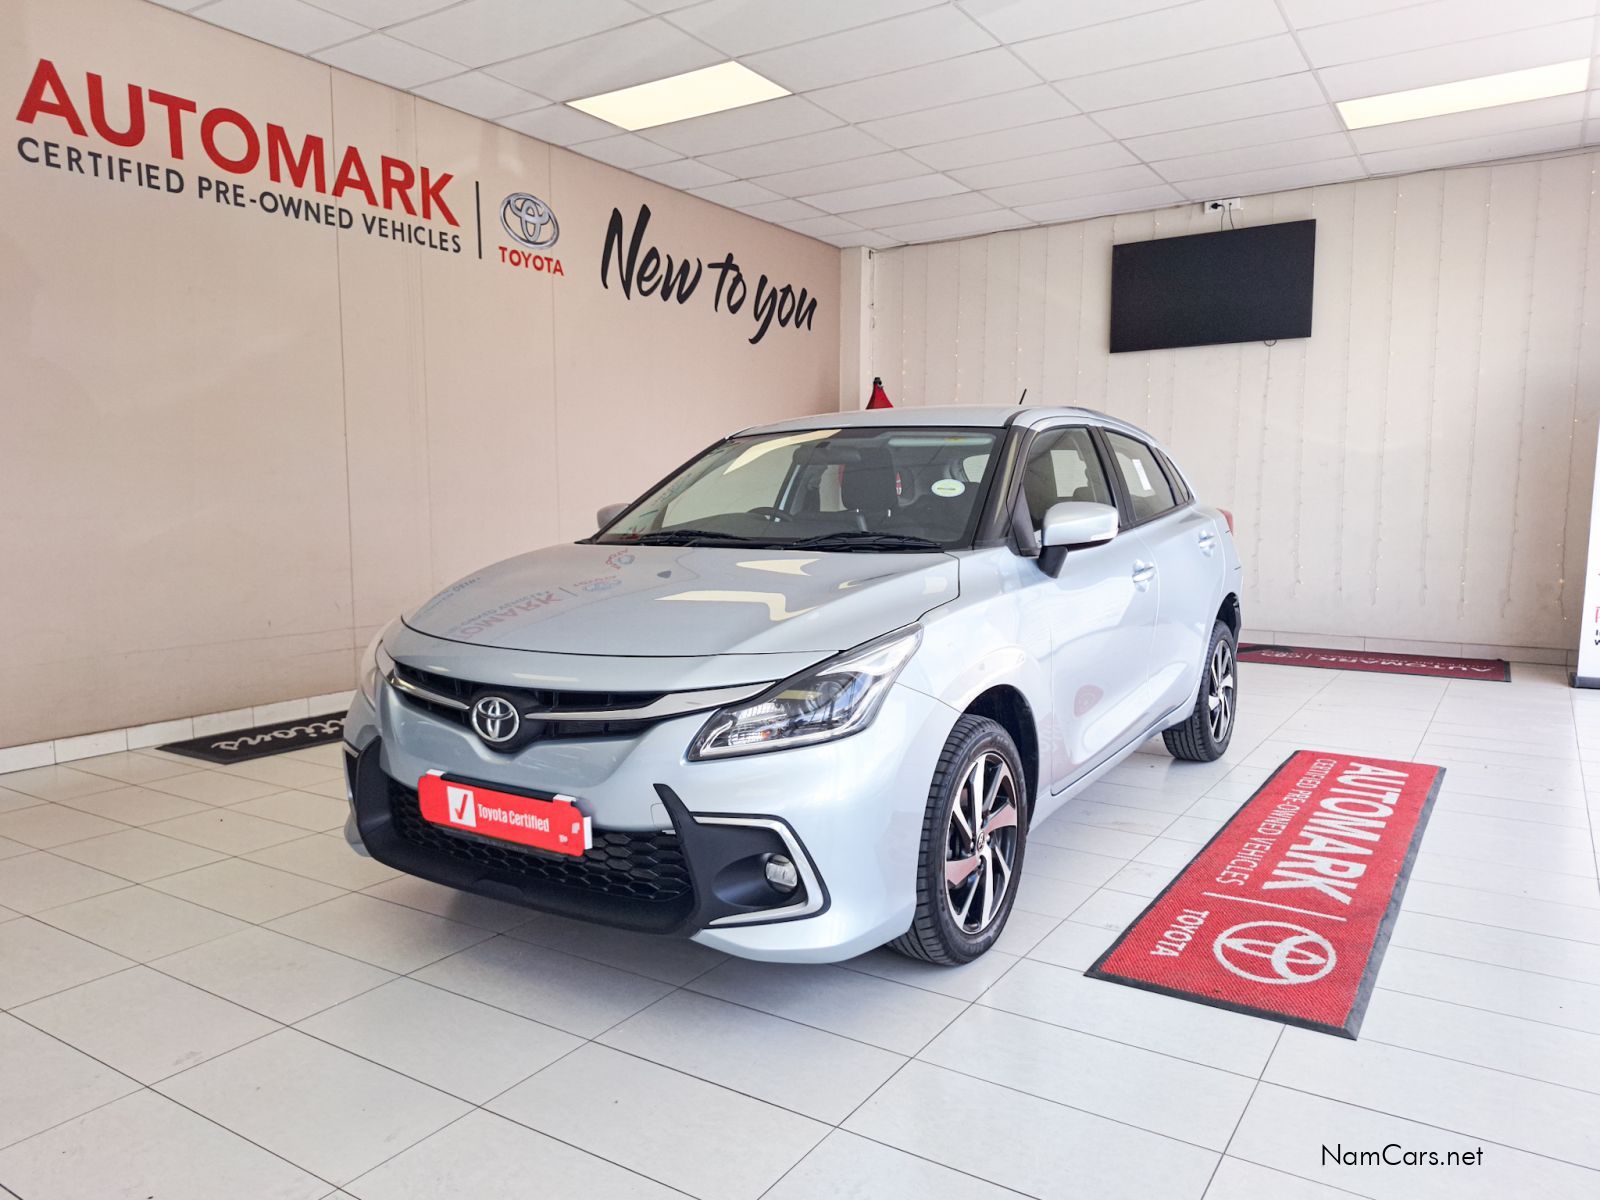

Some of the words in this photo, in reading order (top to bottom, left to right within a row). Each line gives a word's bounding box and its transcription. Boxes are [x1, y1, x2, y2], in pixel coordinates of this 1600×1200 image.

[15, 58, 461, 228] AUTOMARK
[17, 136, 185, 194] CERTIFIED
[198, 175, 354, 230] PRE-OWNED
[361, 213, 462, 254] VEHICLES
[498, 246, 564, 277] TOYOTA
[601, 204, 703, 305] New
[707, 252, 747, 315] to
[748, 274, 818, 345] you
[1295, 758, 1338, 790] CERTIFIED
[477, 803, 508, 824] Toyota
[508, 810, 550, 833] Certified
[1257, 786, 1315, 836] PRE-OWNED
[1262, 762, 1410, 905] AUTOMARK
[1215, 835, 1277, 887] VEHICLES
[1150, 908, 1211, 957] TOYOTA
